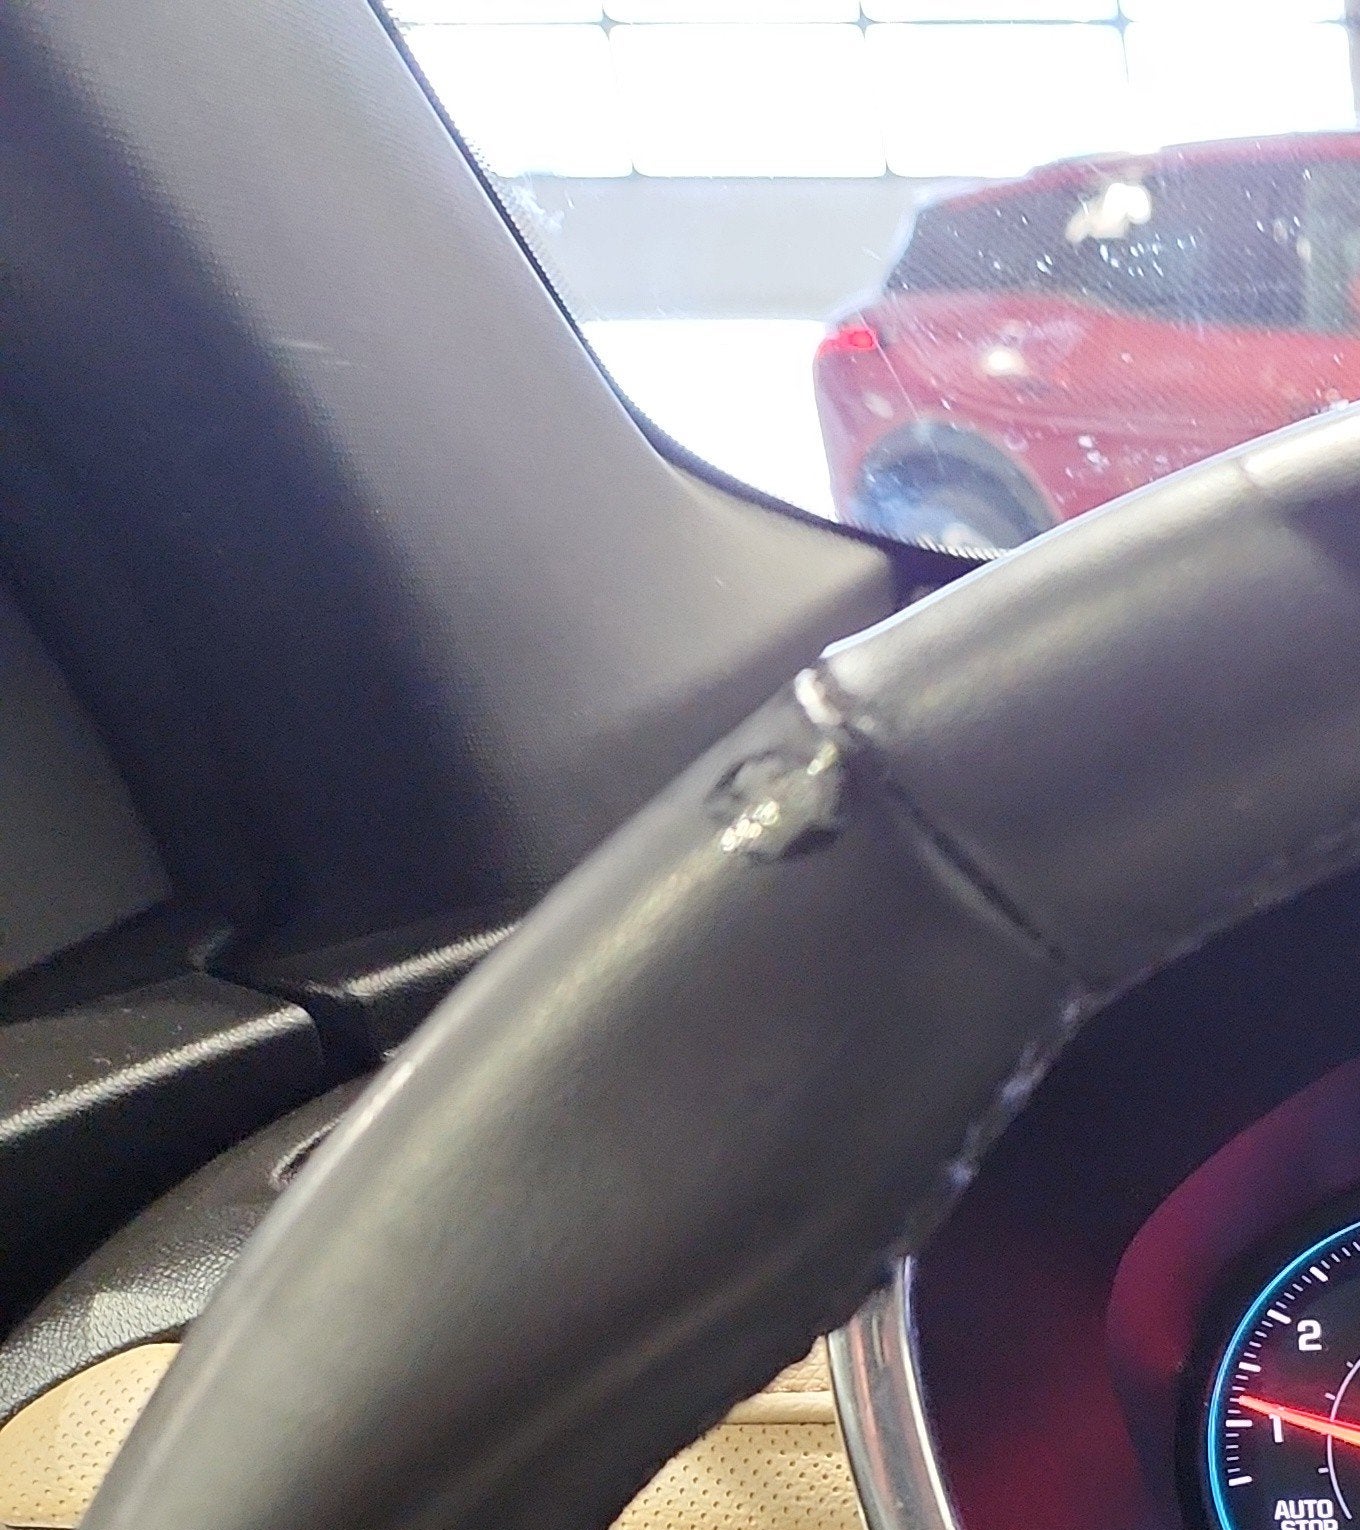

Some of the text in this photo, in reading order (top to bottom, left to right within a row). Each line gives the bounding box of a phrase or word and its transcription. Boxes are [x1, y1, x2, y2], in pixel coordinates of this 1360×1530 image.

[1297, 1319, 1323, 1351] 2
[1268, 1407, 1284, 1443] 1
[1274, 1499, 1334, 1520] AUTO
